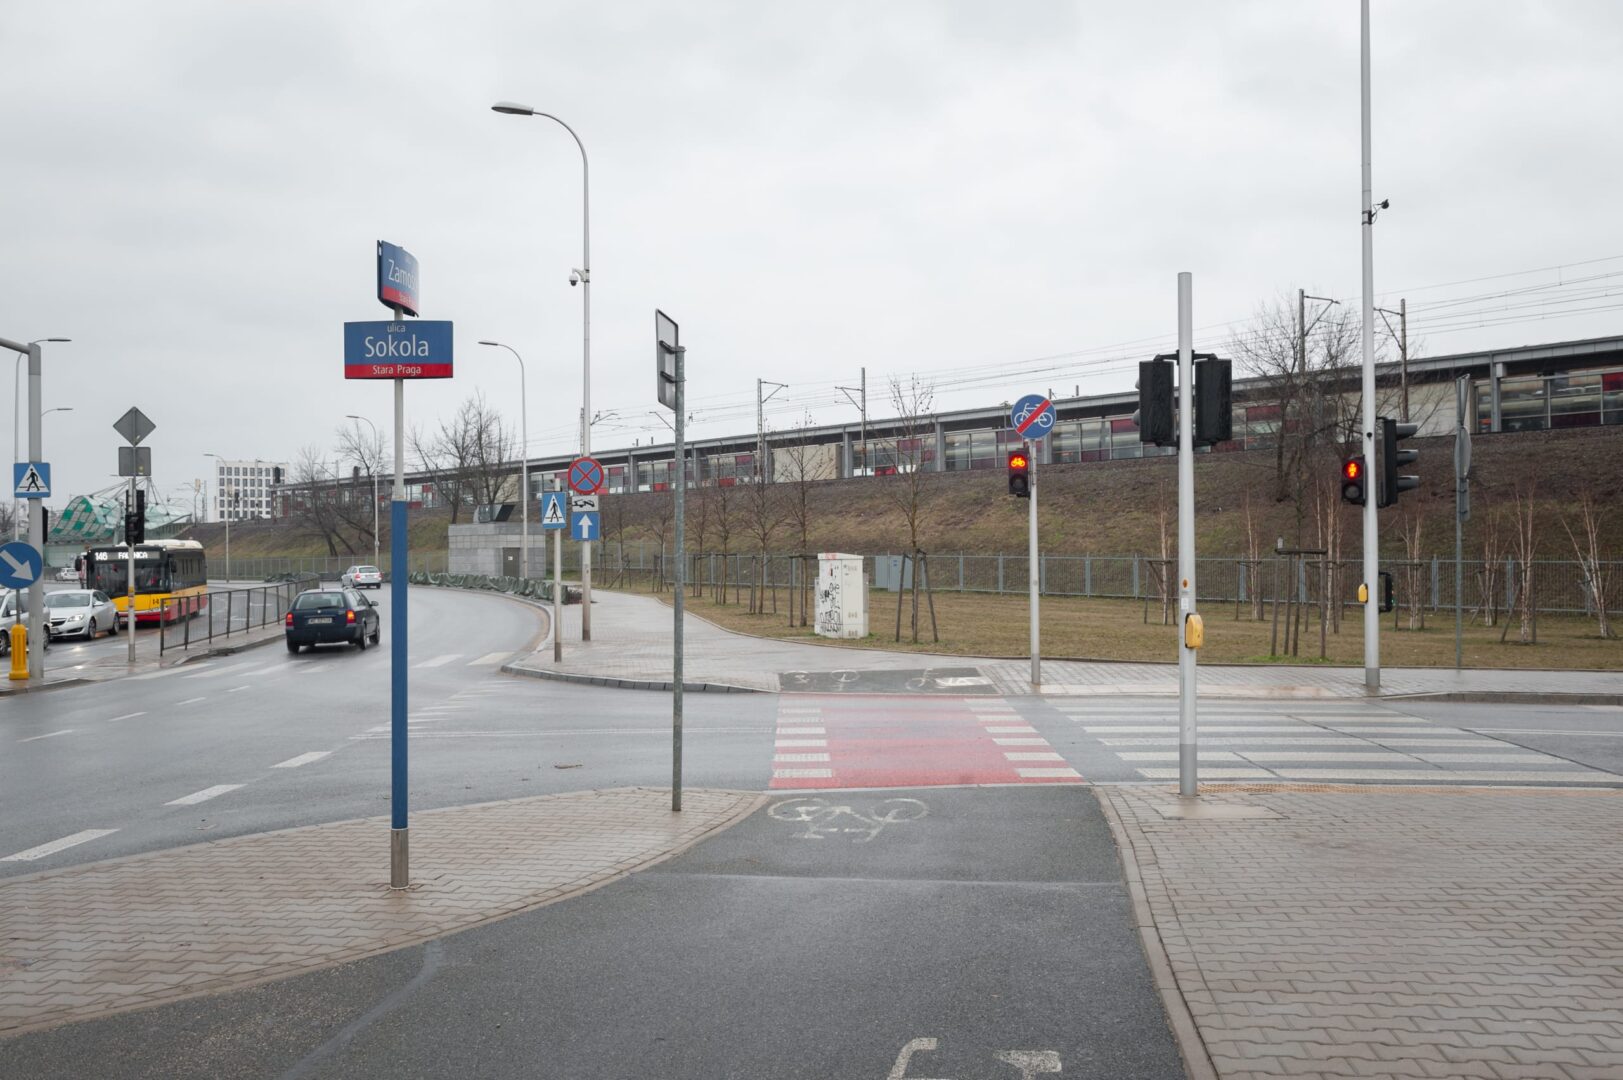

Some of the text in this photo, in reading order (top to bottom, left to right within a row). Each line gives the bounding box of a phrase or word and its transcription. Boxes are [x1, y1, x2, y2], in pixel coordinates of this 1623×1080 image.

[387, 323, 405, 332] ulica
[364, 334, 429, 357] Sokola
[372, 365, 421, 376] Stara Praga
